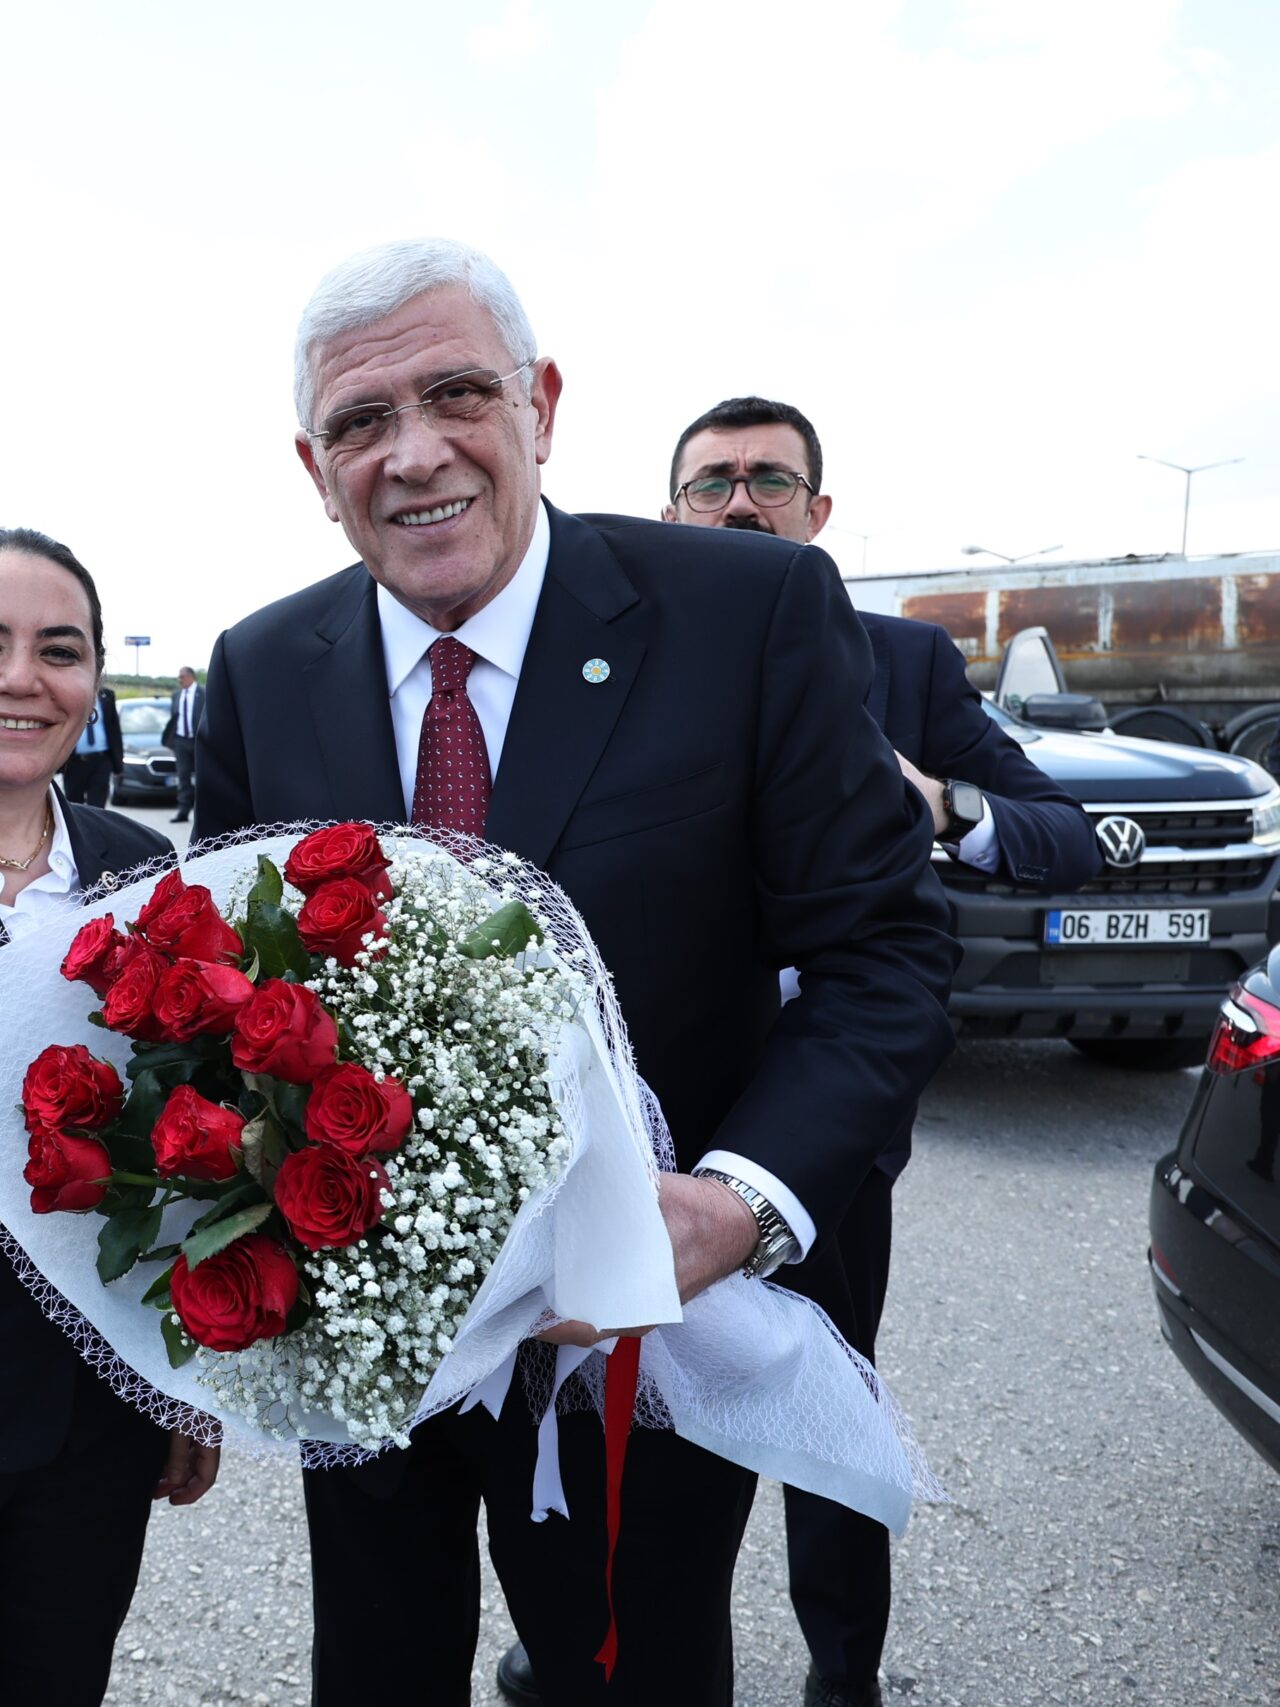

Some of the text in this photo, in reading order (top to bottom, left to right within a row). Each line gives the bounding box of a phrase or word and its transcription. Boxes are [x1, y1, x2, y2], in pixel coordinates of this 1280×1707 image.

[1062, 914, 1090, 940] 06
[1107, 914, 1149, 940] BZH
[1168, 913, 1206, 938] 591
